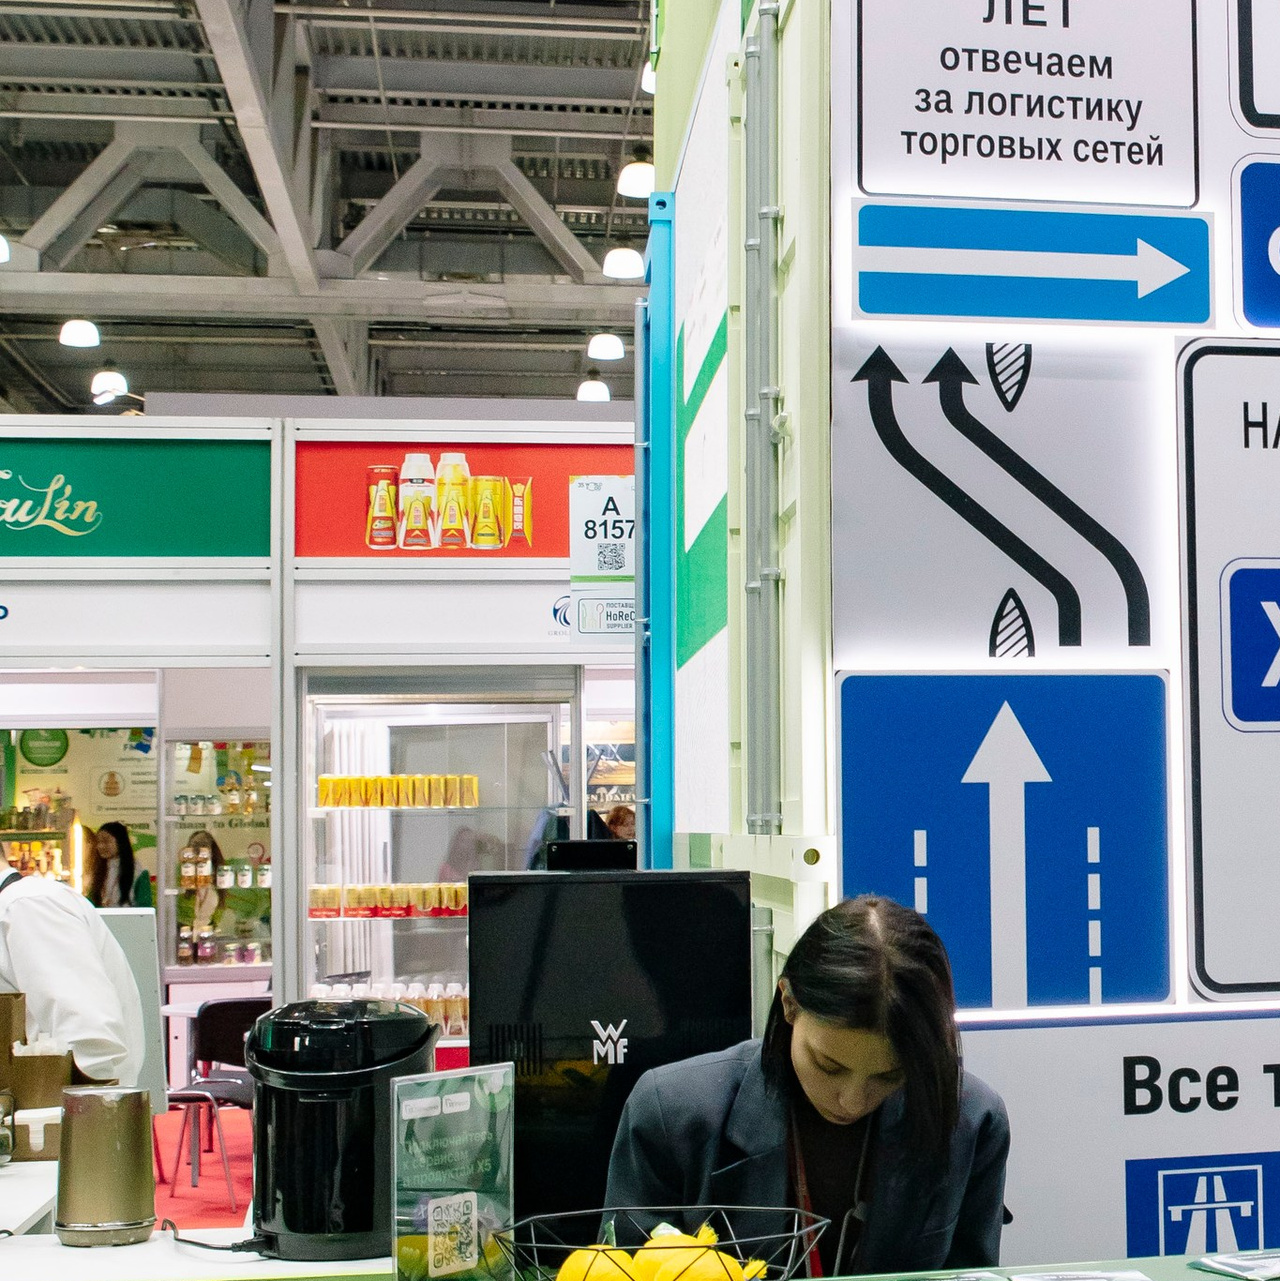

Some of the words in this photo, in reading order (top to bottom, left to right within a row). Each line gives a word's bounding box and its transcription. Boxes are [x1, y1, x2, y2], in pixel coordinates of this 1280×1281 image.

[939, 45, 1113, 80] отвечаем
[914, 87, 953, 114] за
[964, 90, 1143, 131] логистику
[900, 129, 1063, 165] торговых
[1072, 135, 1164, 166] сетей
[0, 470, 103, 536] uLin
[601, 496, 620, 516] A
[584, 519, 635, 540] 8157
[606, 610, 635, 622] HoReC
[590, 1018, 629, 1066] WMF
[1122, 1054, 1240, 1116] Все
